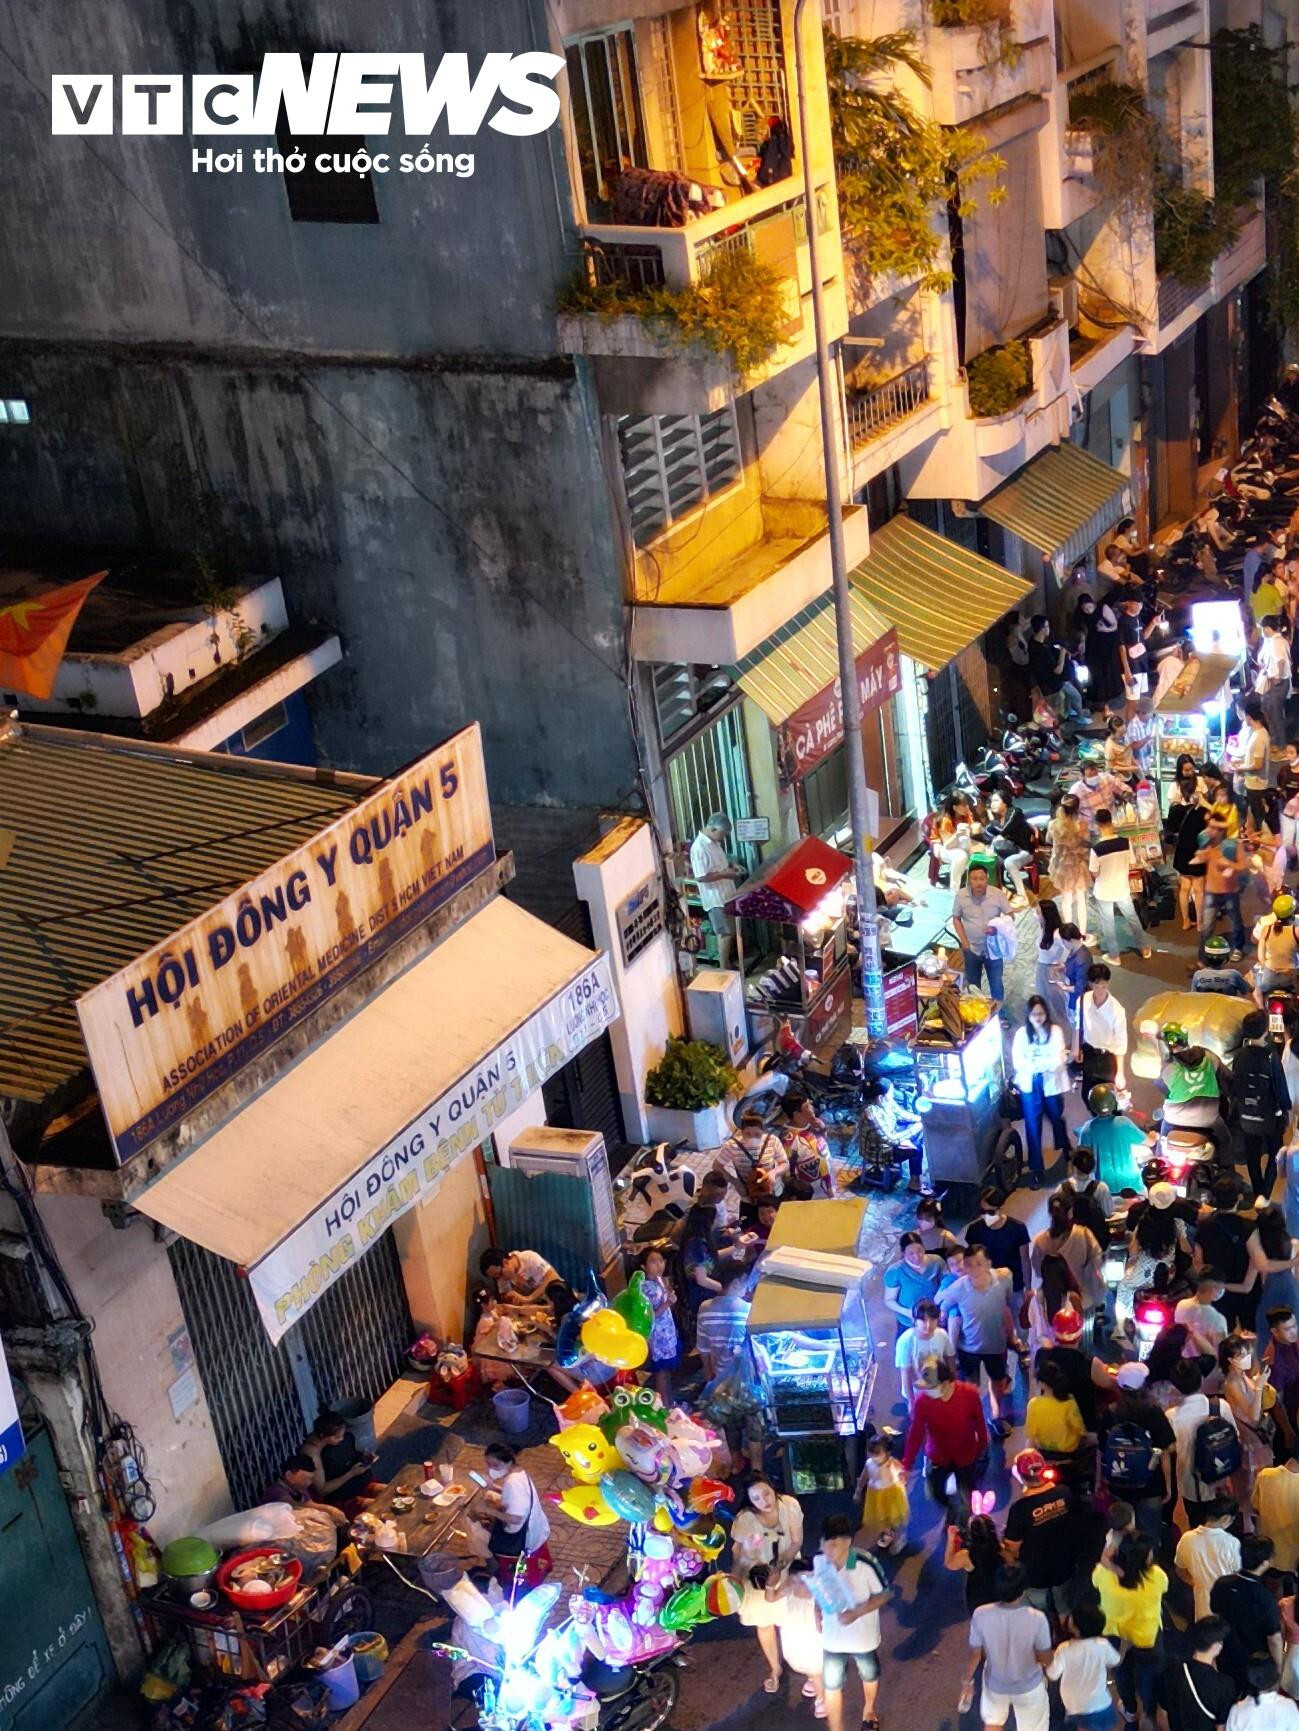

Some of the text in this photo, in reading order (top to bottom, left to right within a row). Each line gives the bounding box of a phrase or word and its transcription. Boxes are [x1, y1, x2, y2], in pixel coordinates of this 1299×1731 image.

[796, 722, 815, 759] CÀ
[816, 701, 836, 743] PHÊ
[861, 665, 883, 703] MÁY
[126, 947, 200, 1029] HỘI
[208, 871, 312, 970] ĐÔNG
[316, 845, 338, 887] Y
[350, 779, 434, 866] QUẬN
[440, 762, 459, 799] 5
[163, 1020, 245, 1093] ASSOCIATION
[245, 1007, 261, 1027] OF
[263, 966, 317, 1016] ORIENTAL
[317, 924, 366, 973] MEDICINE
[399, 884, 420, 907] HCM
[421, 867, 442, 888] VIET
[446, 846, 466, 868] NAM
[568, 972, 601, 1011] 186A
[325, 1051, 516, 1236] HỘI ĐÔNG Y QUẬN 5
[275, 1234, 356, 1326] PHÒNG
[356, 1169, 420, 1246] KHÁM
[423, 1115, 479, 1182] BỆNH
[0, 1676, 26, 1712] HÔNG
